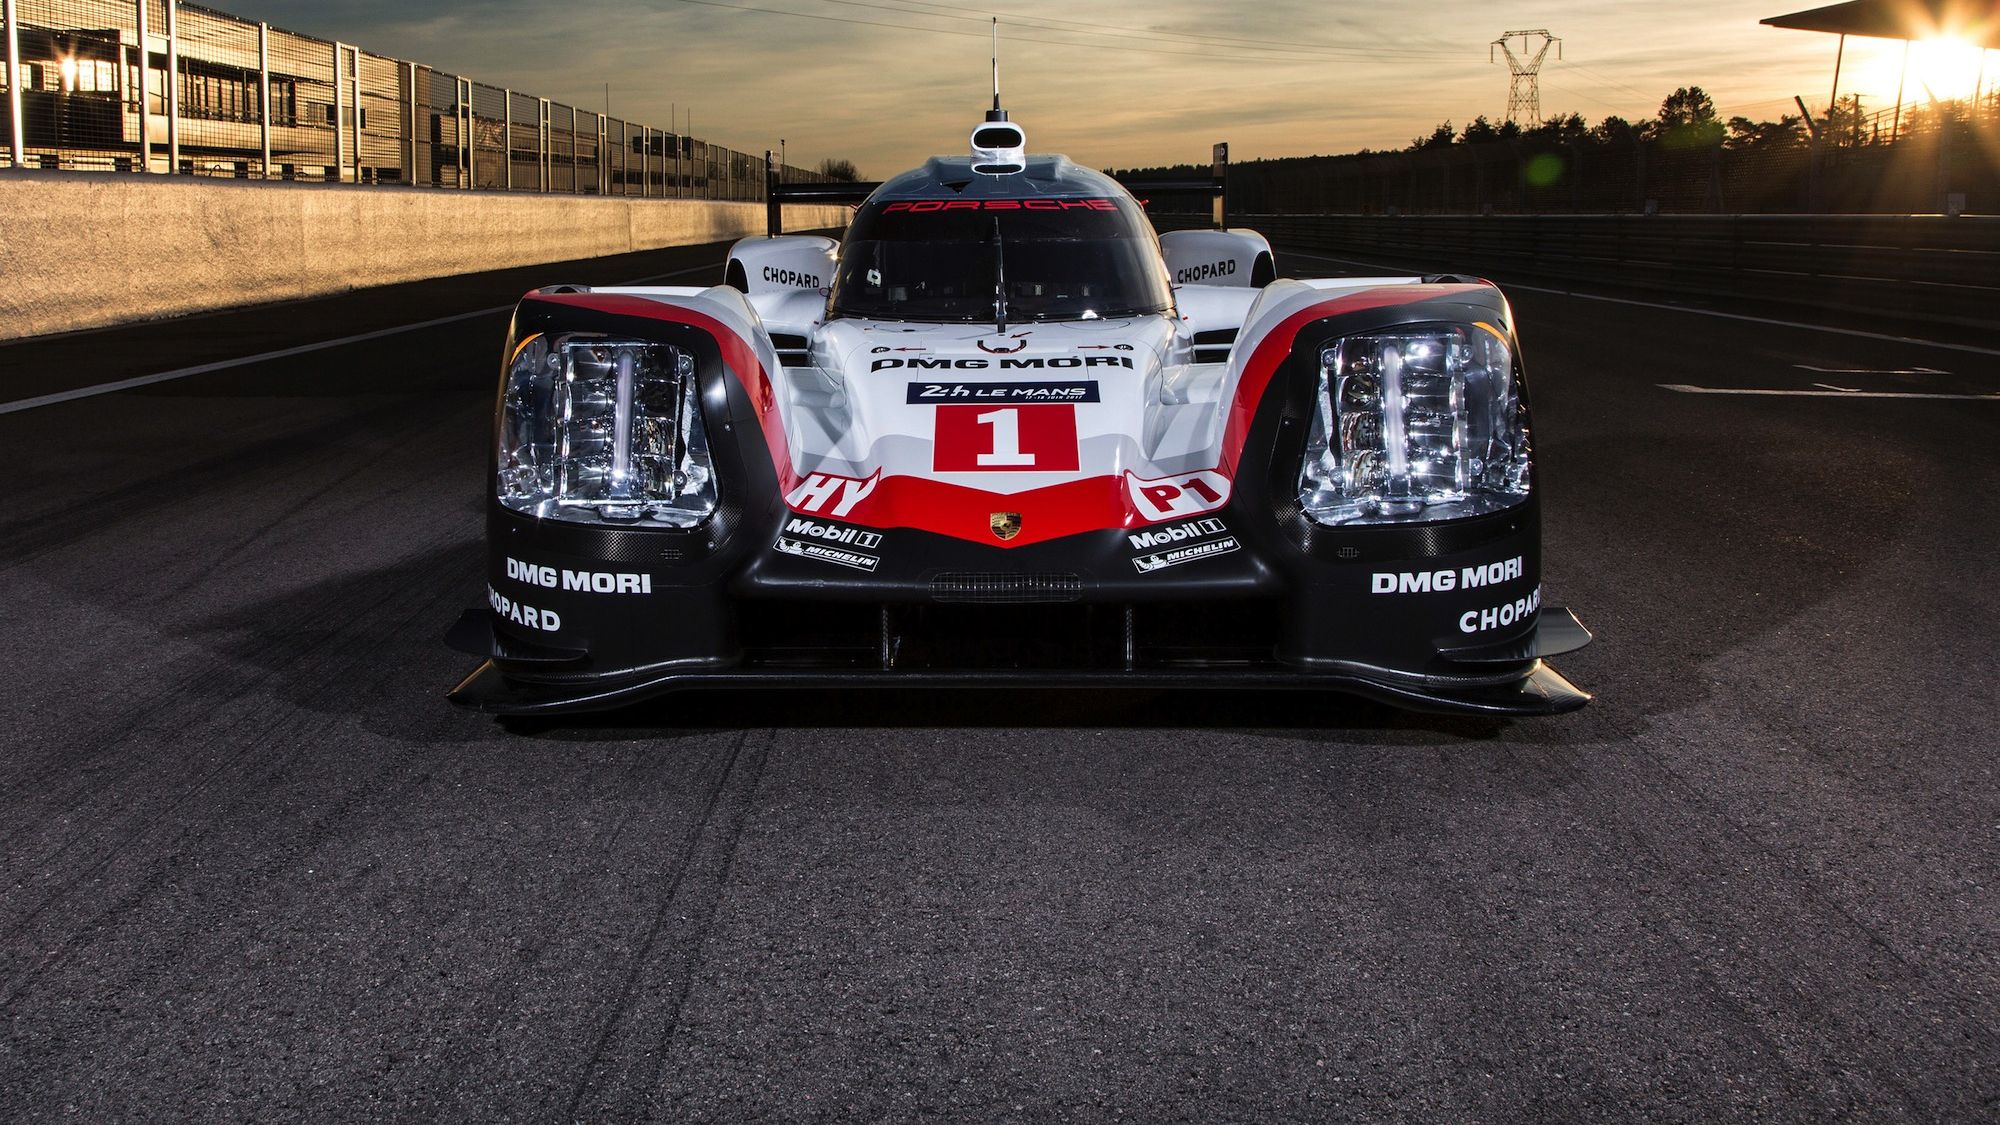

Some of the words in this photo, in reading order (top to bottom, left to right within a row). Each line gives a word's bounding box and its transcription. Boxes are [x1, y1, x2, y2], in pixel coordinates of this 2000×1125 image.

[882, 200, 1119, 214] PORSCHE
[763, 266, 820, 288] CHOPARD
[1177, 259, 1236, 283] CHOPARD
[871, 358, 988, 373] DMG
[1000, 356, 1134, 370] MORI
[975, 388, 1007, 397] LE
[1011, 387, 1087, 397] MANS
[976, 408, 1036, 467] 1
[785, 473, 879, 517] HY
[1139, 478, 1222, 512] P1
[786, 518, 858, 544] Mobil
[1128, 521, 1202, 550] Mobil
[805, 546, 876, 567] MICHELIN
[1167, 540, 1234, 560] MICHELIN
[507, 557, 558, 588] DMG
[562, 569, 652, 595] MORI
[1371, 570, 1457, 594] DMG
[1462, 556, 1523, 589] MORI
